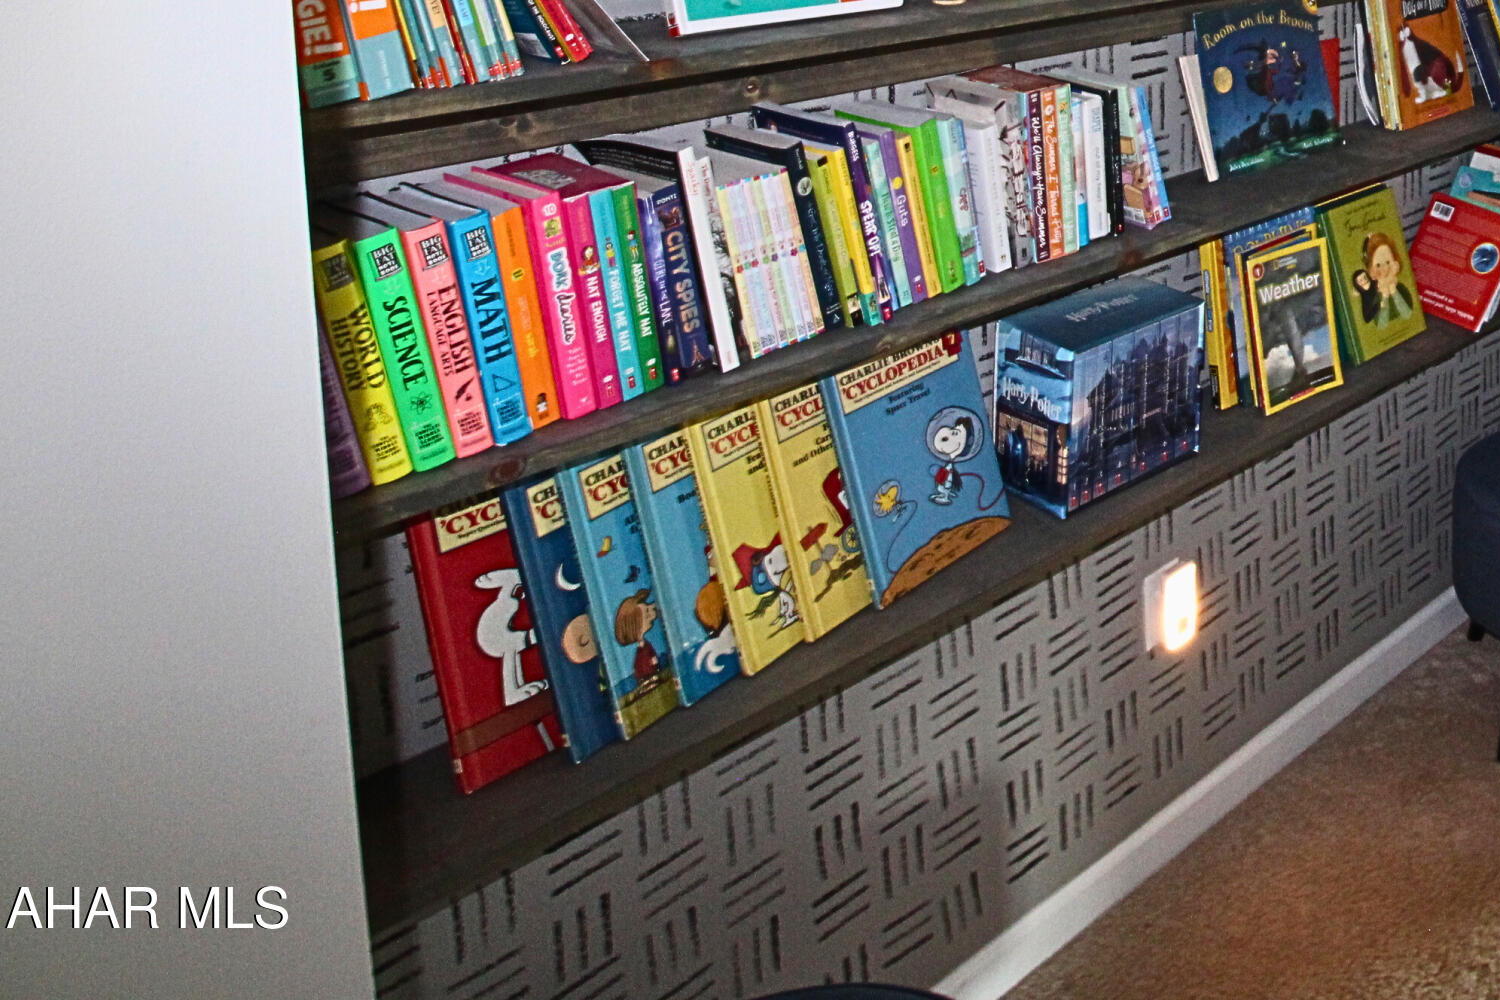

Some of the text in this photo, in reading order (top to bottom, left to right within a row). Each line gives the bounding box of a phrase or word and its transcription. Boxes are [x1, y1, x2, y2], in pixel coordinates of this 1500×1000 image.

[536, 13, 556, 43] HOLOCAUST
[1202, 9, 1314, 50] Room on the Broom
[1044, 115, 1056, 134] The
[1028, 143, 1047, 181] Always
[1044, 135, 1062, 172] Summer
[894, 194, 912, 227] Guts
[1033, 205, 1050, 249] Summer
[373, 245, 393, 257] BIG
[421, 235, 441, 248] BIG
[466, 227, 485, 239] BIG
[548, 250, 571, 290] DORK
[665, 229, 702, 334] CITY SPIES
[1259, 272, 1321, 305] Weather
[469, 275, 515, 365] MATH
[555, 291, 583, 344] diaries
[584, 276, 610, 343] NAT ENOUGH
[604, 269, 633, 353] FORGET ME NAT
[628, 262, 654, 338] ABSOLUTELY NAT
[350, 302, 386, 389] WORLD
[383, 296, 428, 391] SCIENCE
[426, 290, 455, 377] LANGUAGE ARTS
[437, 285, 474, 375] ENGLISH
[947, 334, 955, 345] 7
[331, 317, 366, 391] HISTORY
[840, 355, 891, 386] CHARLIE
[1001, 375, 1062, 422] Harry Potter
